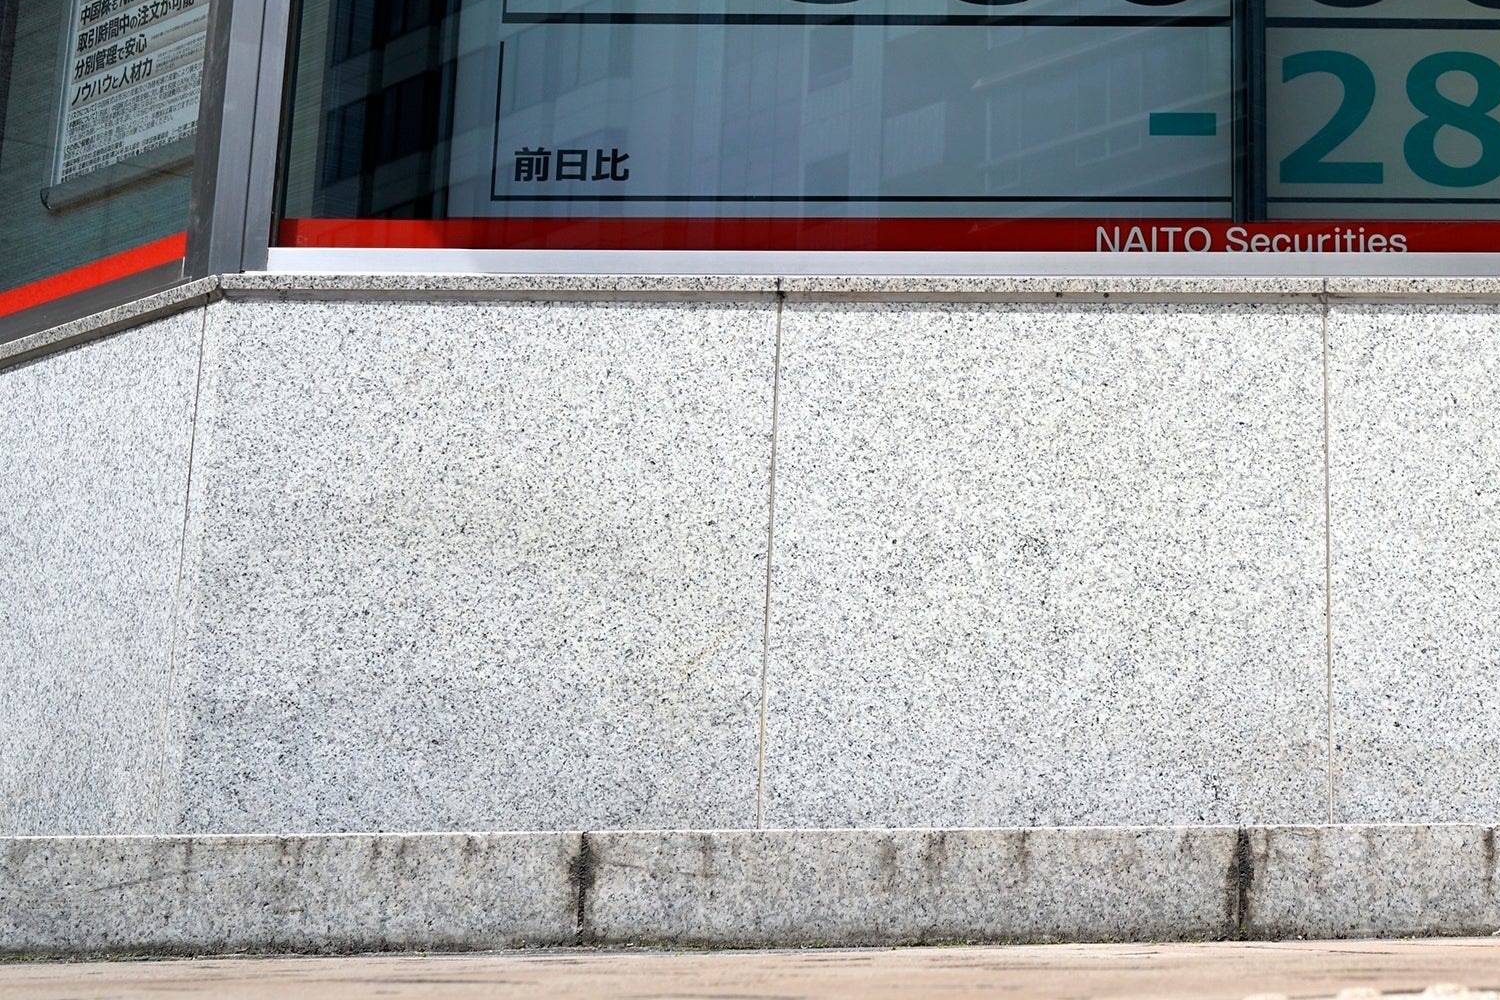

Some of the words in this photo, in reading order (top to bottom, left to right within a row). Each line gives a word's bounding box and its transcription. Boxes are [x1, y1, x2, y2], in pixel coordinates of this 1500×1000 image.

[74, 34, 147, 80] 分別管理で安心
[72, 58, 153, 106] ノウハウと人材力
[514, 146, 630, 182] 前日比
[1096, 226, 1212, 252] NAITO
[1225, 226, 1408, 253] Securities
